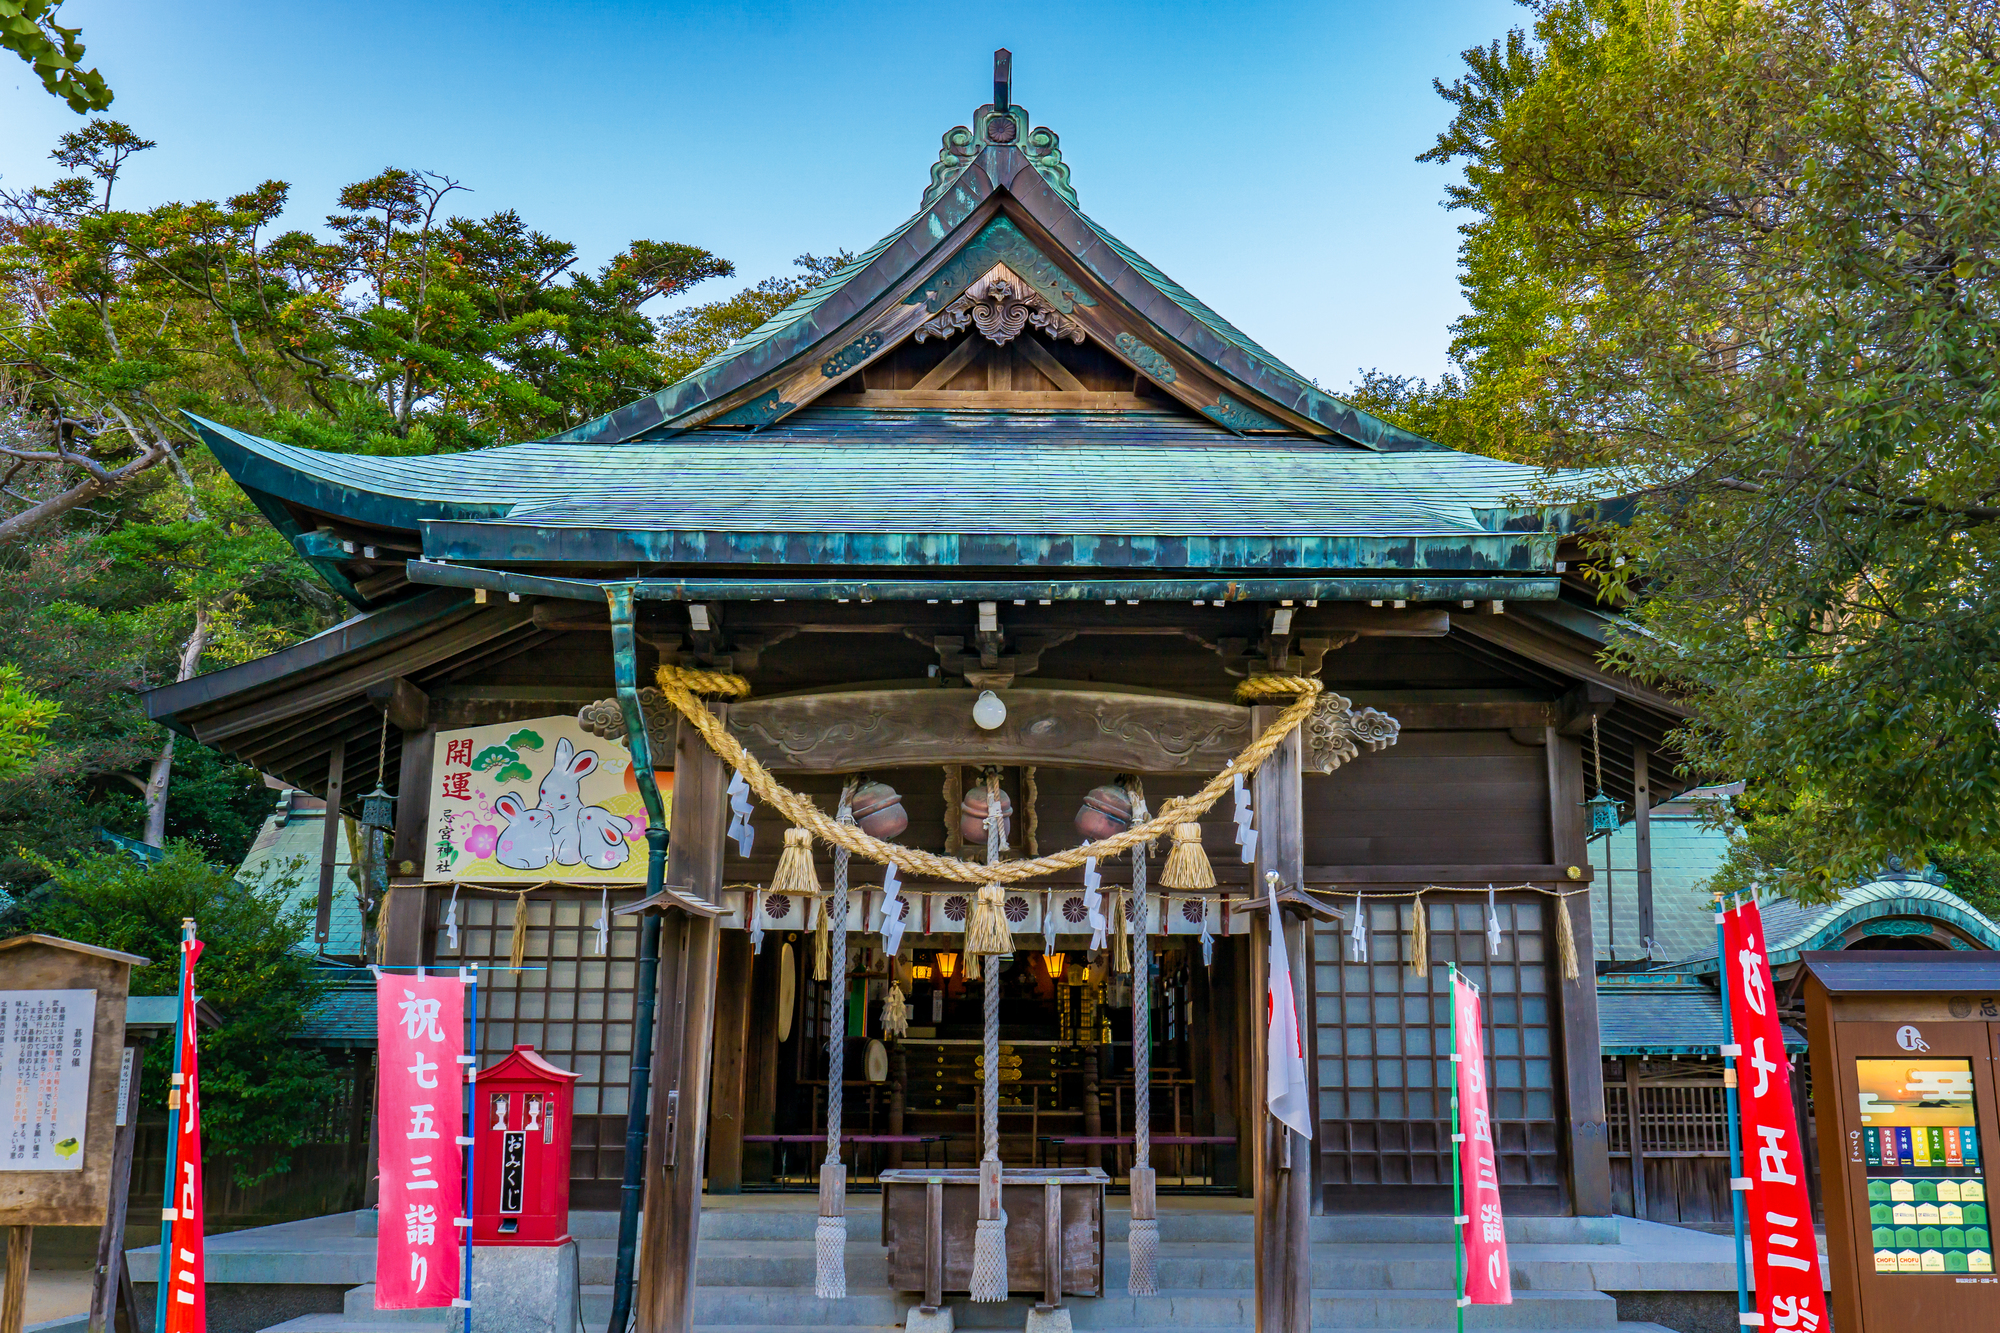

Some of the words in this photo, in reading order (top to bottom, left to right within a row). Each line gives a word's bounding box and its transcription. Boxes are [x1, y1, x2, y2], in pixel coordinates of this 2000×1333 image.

[442, 738, 474, 801] 開運
[436, 809, 455, 874] 忌宮神社
[13, 1000, 22, 1043] 味もあります
[1979, 997, 1998, 1017] 忌
[71, 1028, 83, 1067] 碁盤の儀
[398, 989, 446, 1294] 祝七五三詣り
[506, 1135, 523, 1211] おみくじ
